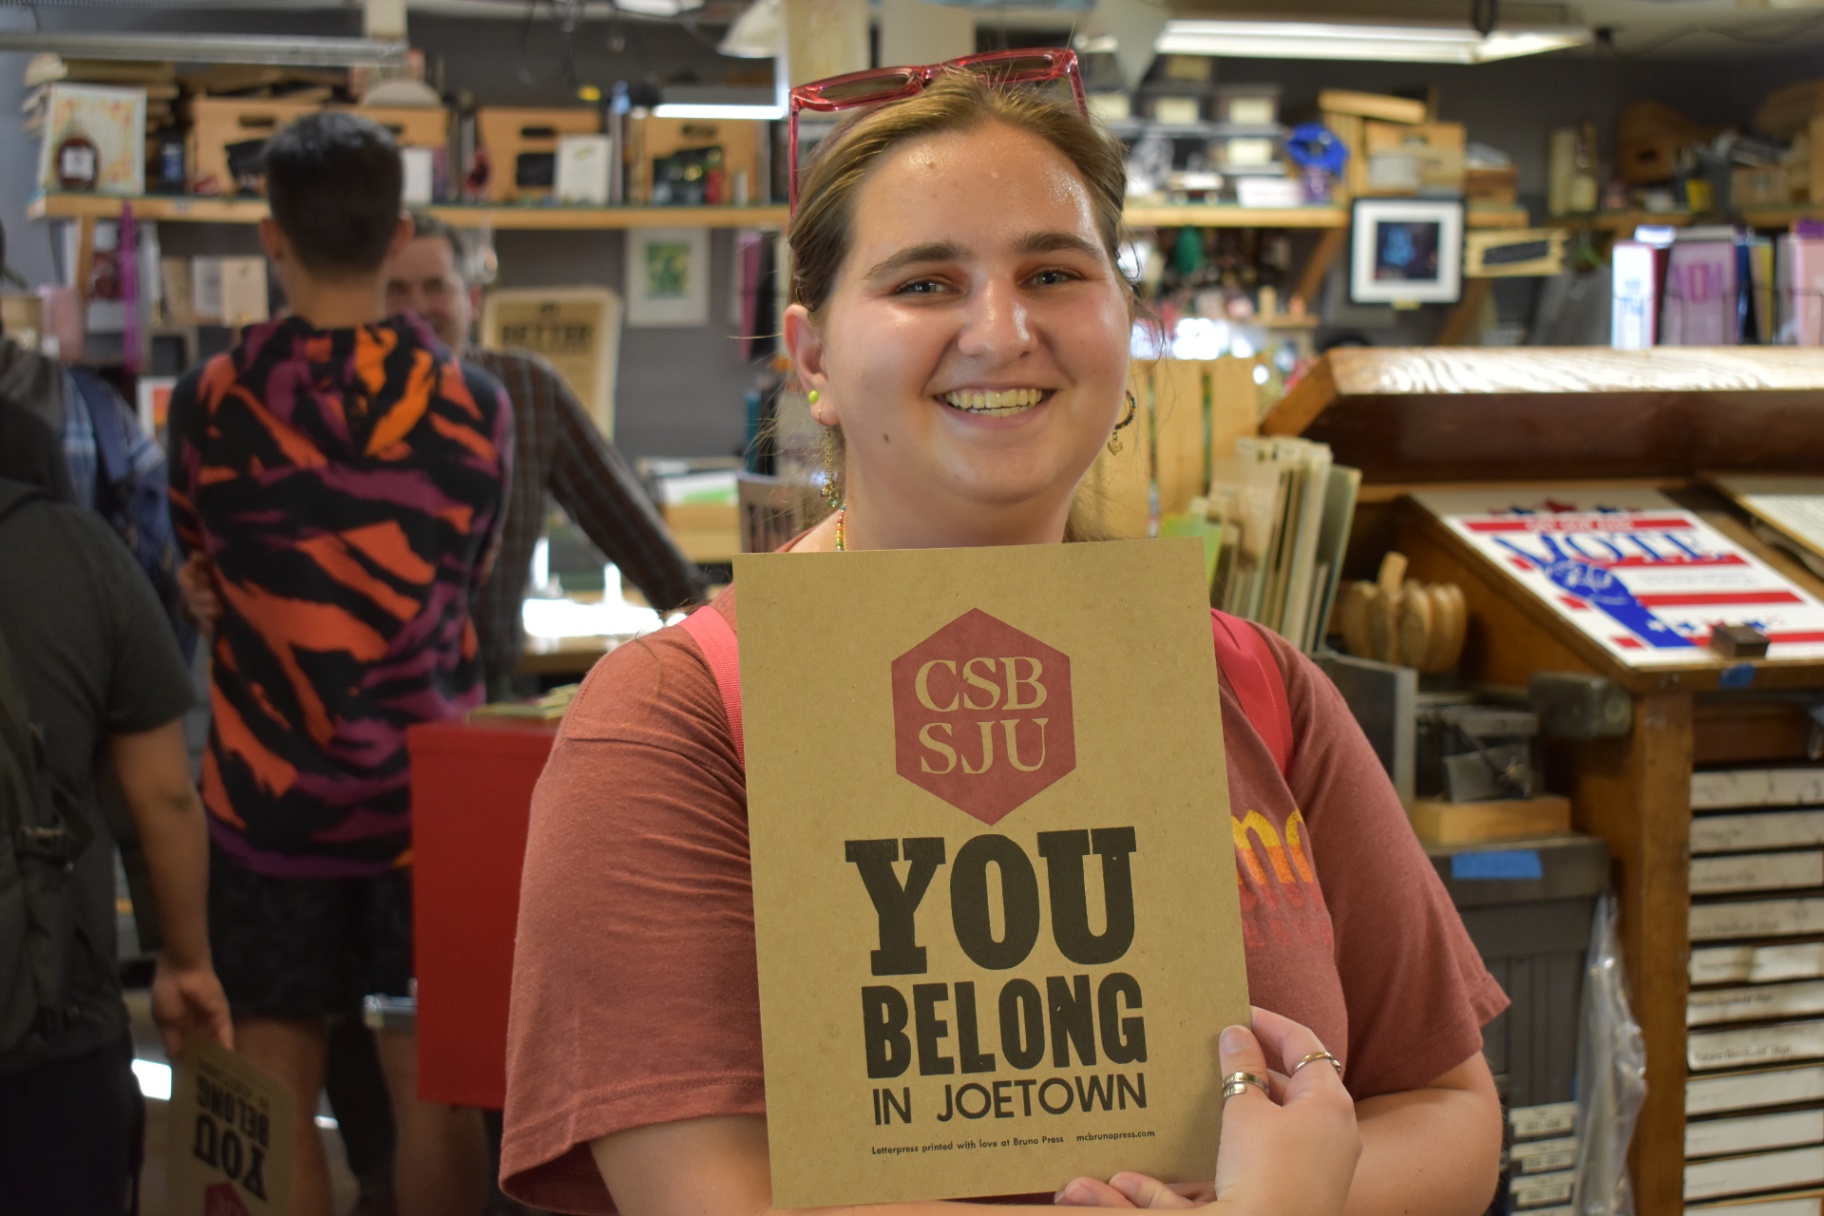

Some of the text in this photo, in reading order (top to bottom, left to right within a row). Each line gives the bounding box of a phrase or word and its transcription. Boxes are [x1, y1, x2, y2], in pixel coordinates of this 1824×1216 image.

[1493, 532, 1726, 563] VOTE
[914, 656, 1048, 713] CSB
[919, 717, 1049, 775] SJU
[844, 826, 1137, 976] YOU
[861, 972, 1148, 1079] BELONG
[872, 1072, 1148, 1126] IN JOETOWN
[194, 1114, 268, 1201] YOU
[871, 1129, 1155, 1155] Letterpress printed with love at Bruno Press mcbrunopress.com
